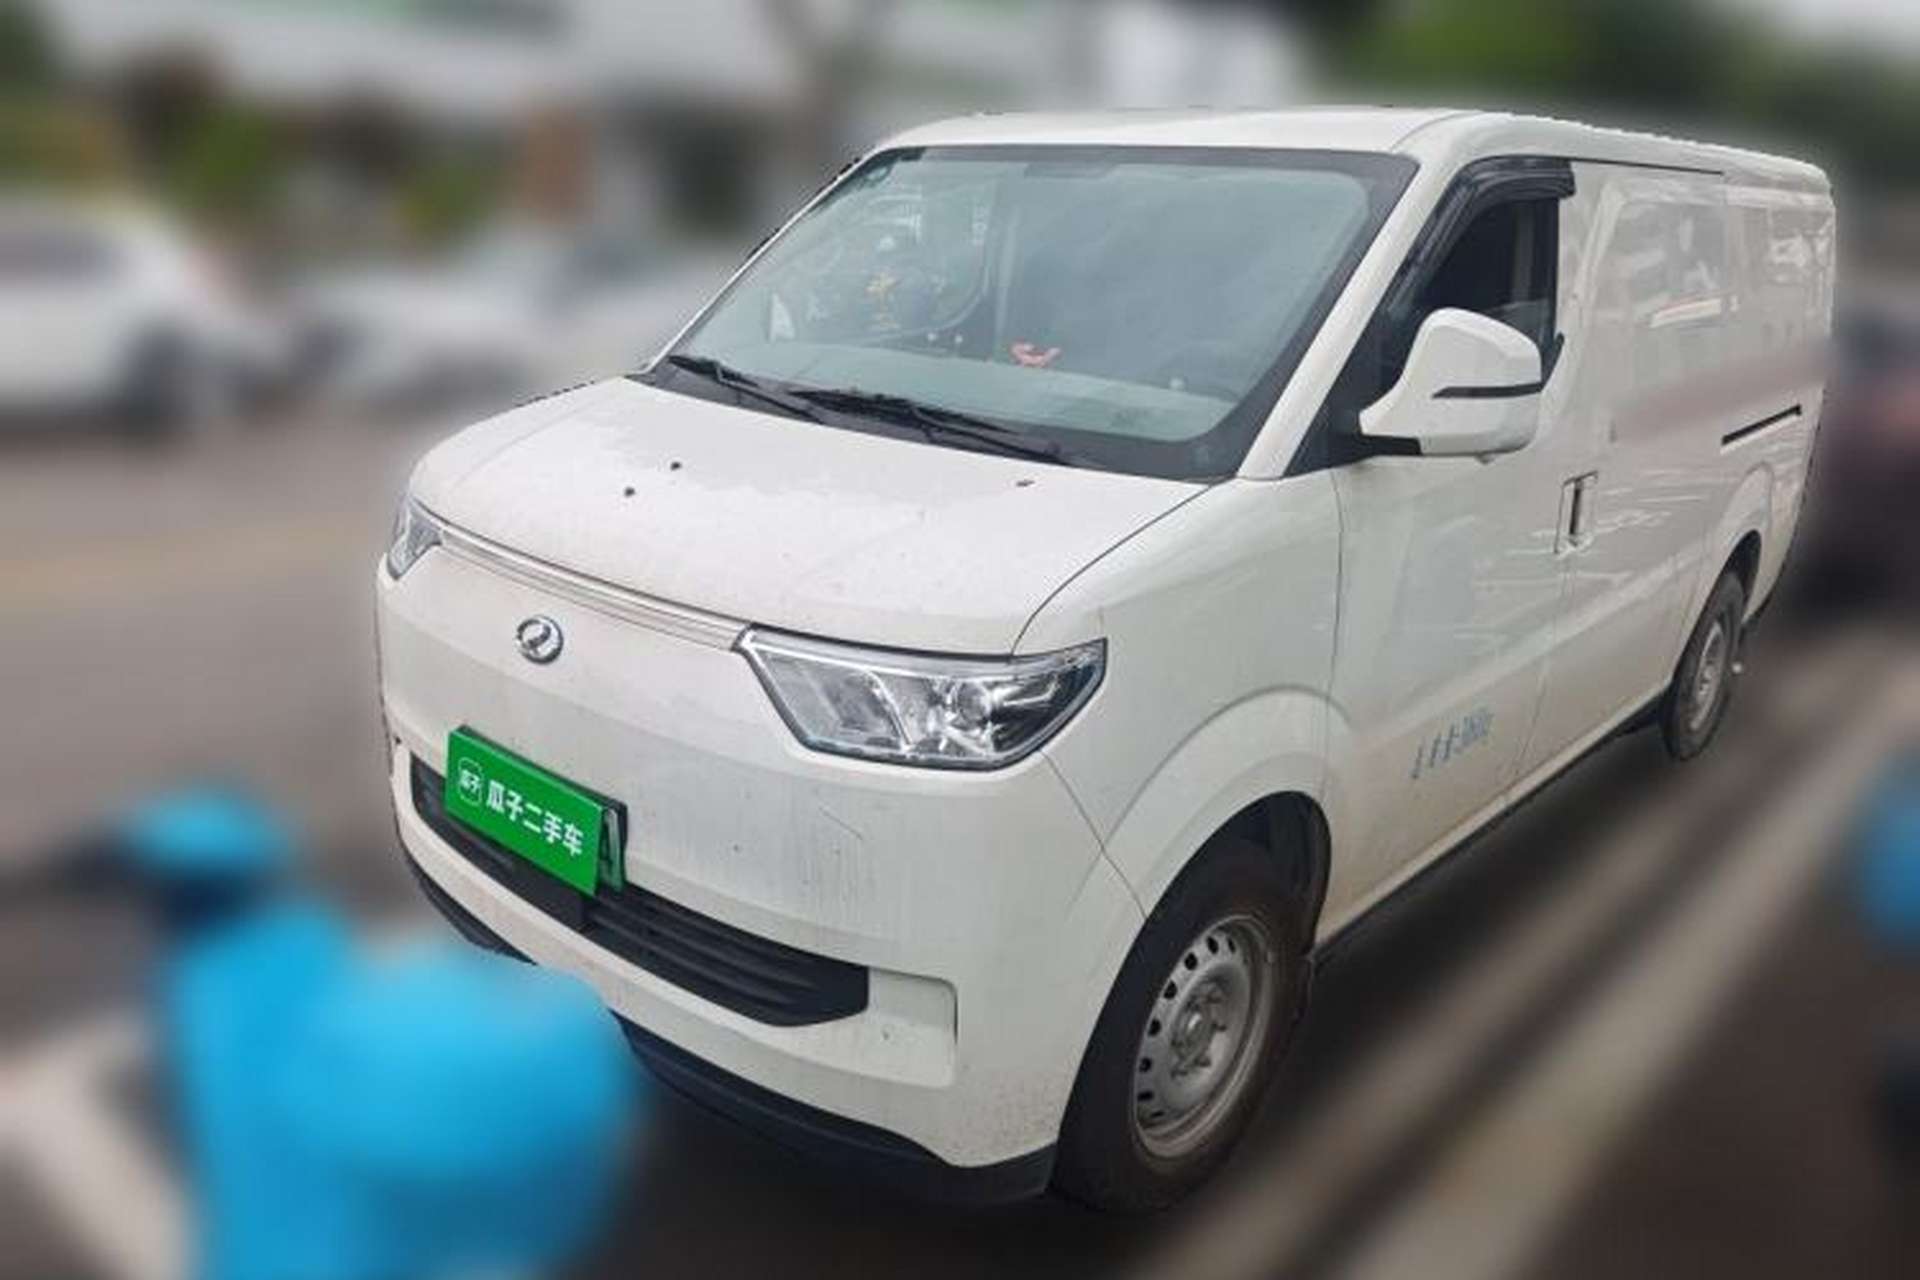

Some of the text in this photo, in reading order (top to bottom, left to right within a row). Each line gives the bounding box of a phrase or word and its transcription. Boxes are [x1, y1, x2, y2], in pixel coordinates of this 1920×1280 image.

[485, 780, 584, 857] 瓜子二手车
